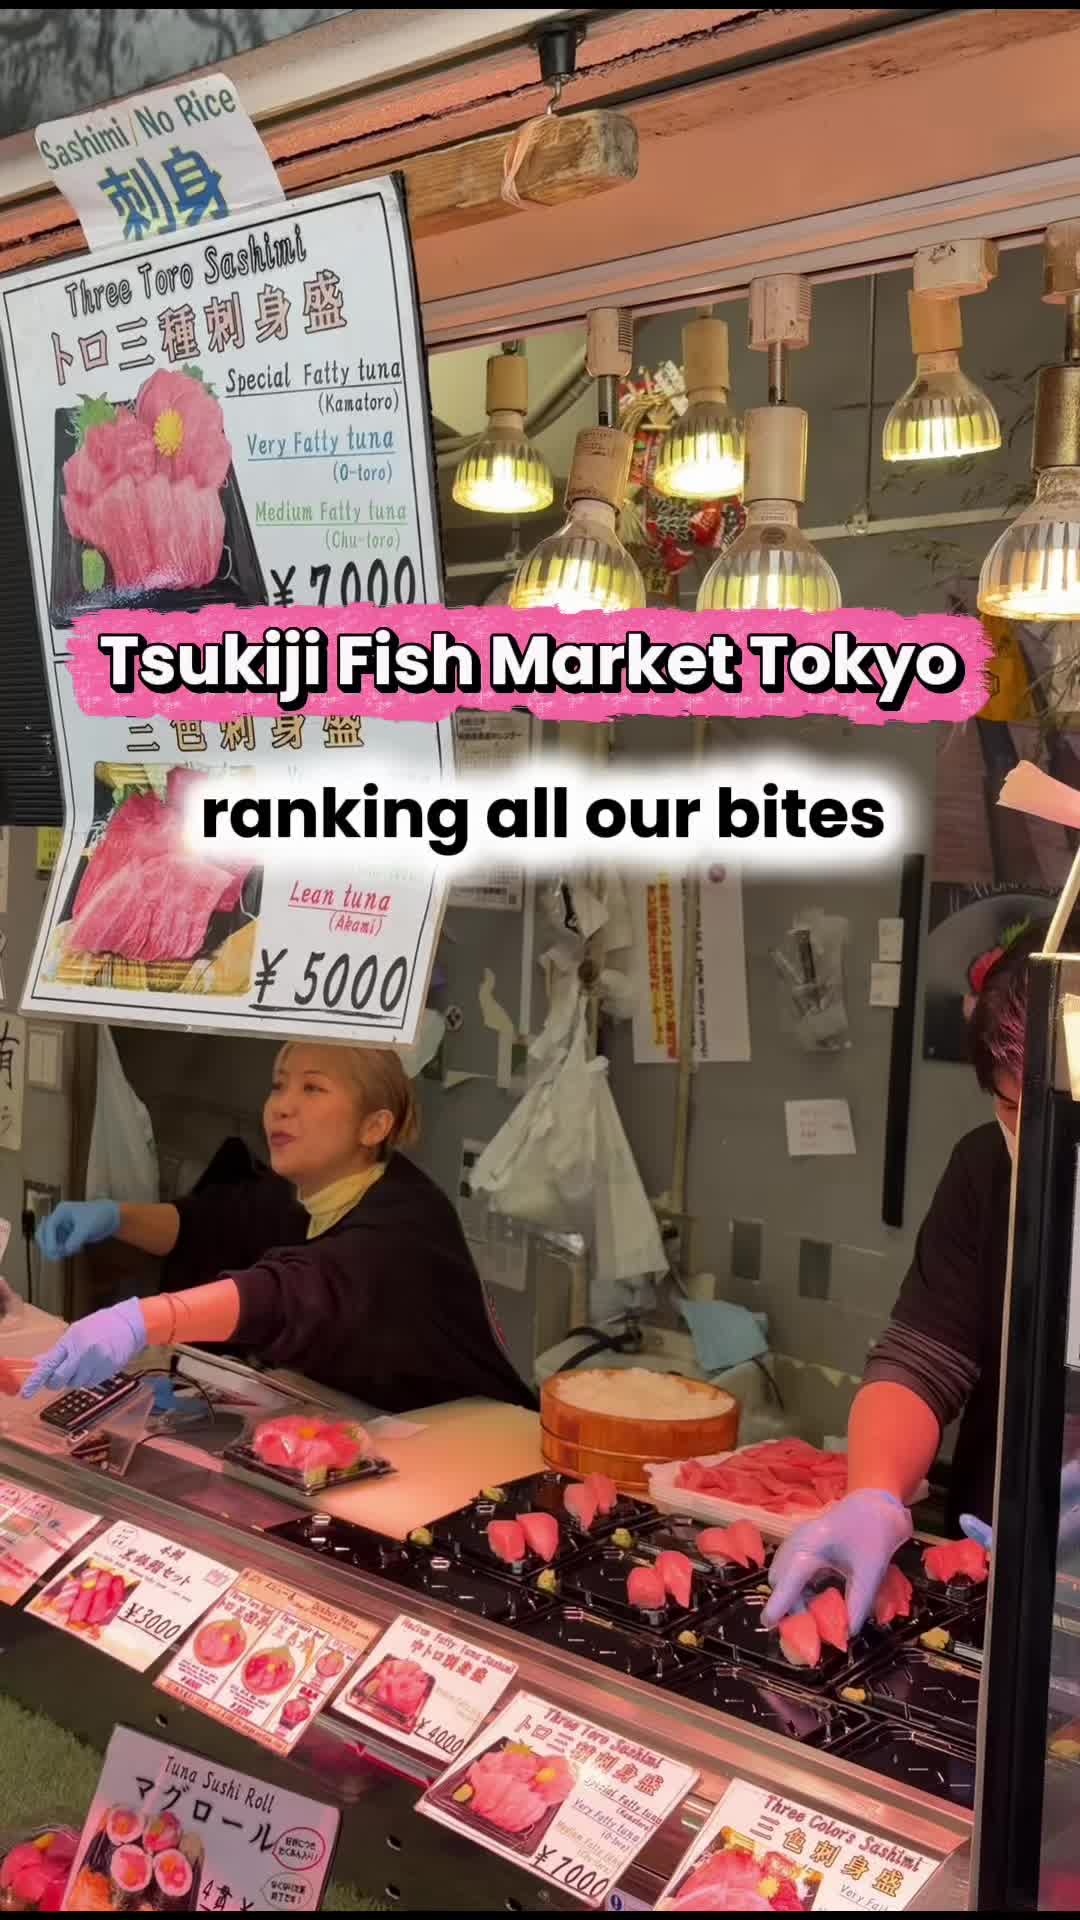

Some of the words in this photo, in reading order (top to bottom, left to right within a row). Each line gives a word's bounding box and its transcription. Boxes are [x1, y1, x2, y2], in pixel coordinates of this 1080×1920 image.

[40, 117, 130, 169] Sashimi
[134, 106, 175, 139] No
[174, 87, 237, 127] Rice
[96, 146, 230, 240] 刺身
[65, 279, 132, 317] Three
[139, 263, 194, 298] Toro
[204, 224, 307, 284] Sashimi
[50, 269, 348, 387] トロ三種刺身盛
[225, 362, 291, 395] Special
[304, 361, 349, 385] Fatty
[358, 358, 402, 380] tuna
[318, 389, 400, 415] (Kamatoro)
[247, 434, 286, 457] Very
[294, 432, 339, 455] Fatty
[348, 425, 394, 450] tuna
[333, 461, 393, 484] (O-toro)
[255, 501, 313, 521] Medium
[320, 502, 361, 523] Fatty
[369, 501, 408, 519] tuna
[325, 528, 401, 550] (Chu-toro)
[289, 880, 335, 906] Lean
[343, 884, 392, 911] tuna
[328, 913, 383, 937] (Akami)
[125, 1603, 181, 1640] ¥3000
[417, 1717, 465, 1753] ¥4000
[544, 1708, 579, 1731] Three
[581, 1725, 610, 1745] Toro
[610, 1739, 665, 1769] Sashimi
[164, 1756, 198, 1783] Tuna
[202, 1771, 240, 1801] Sushi
[245, 1787, 275, 1814] Roll
[618, 1795, 643, 1811] Fatty
[135, 1776, 275, 1852] マグロール
[573, 1799, 594, 1816] Very
[595, 1810, 620, 1828] Fatty
[764, 1794, 807, 1823] Three
[858, 1835, 923, 1873] Sashimi
[750, 1815, 906, 1898] 三色刺身盛
